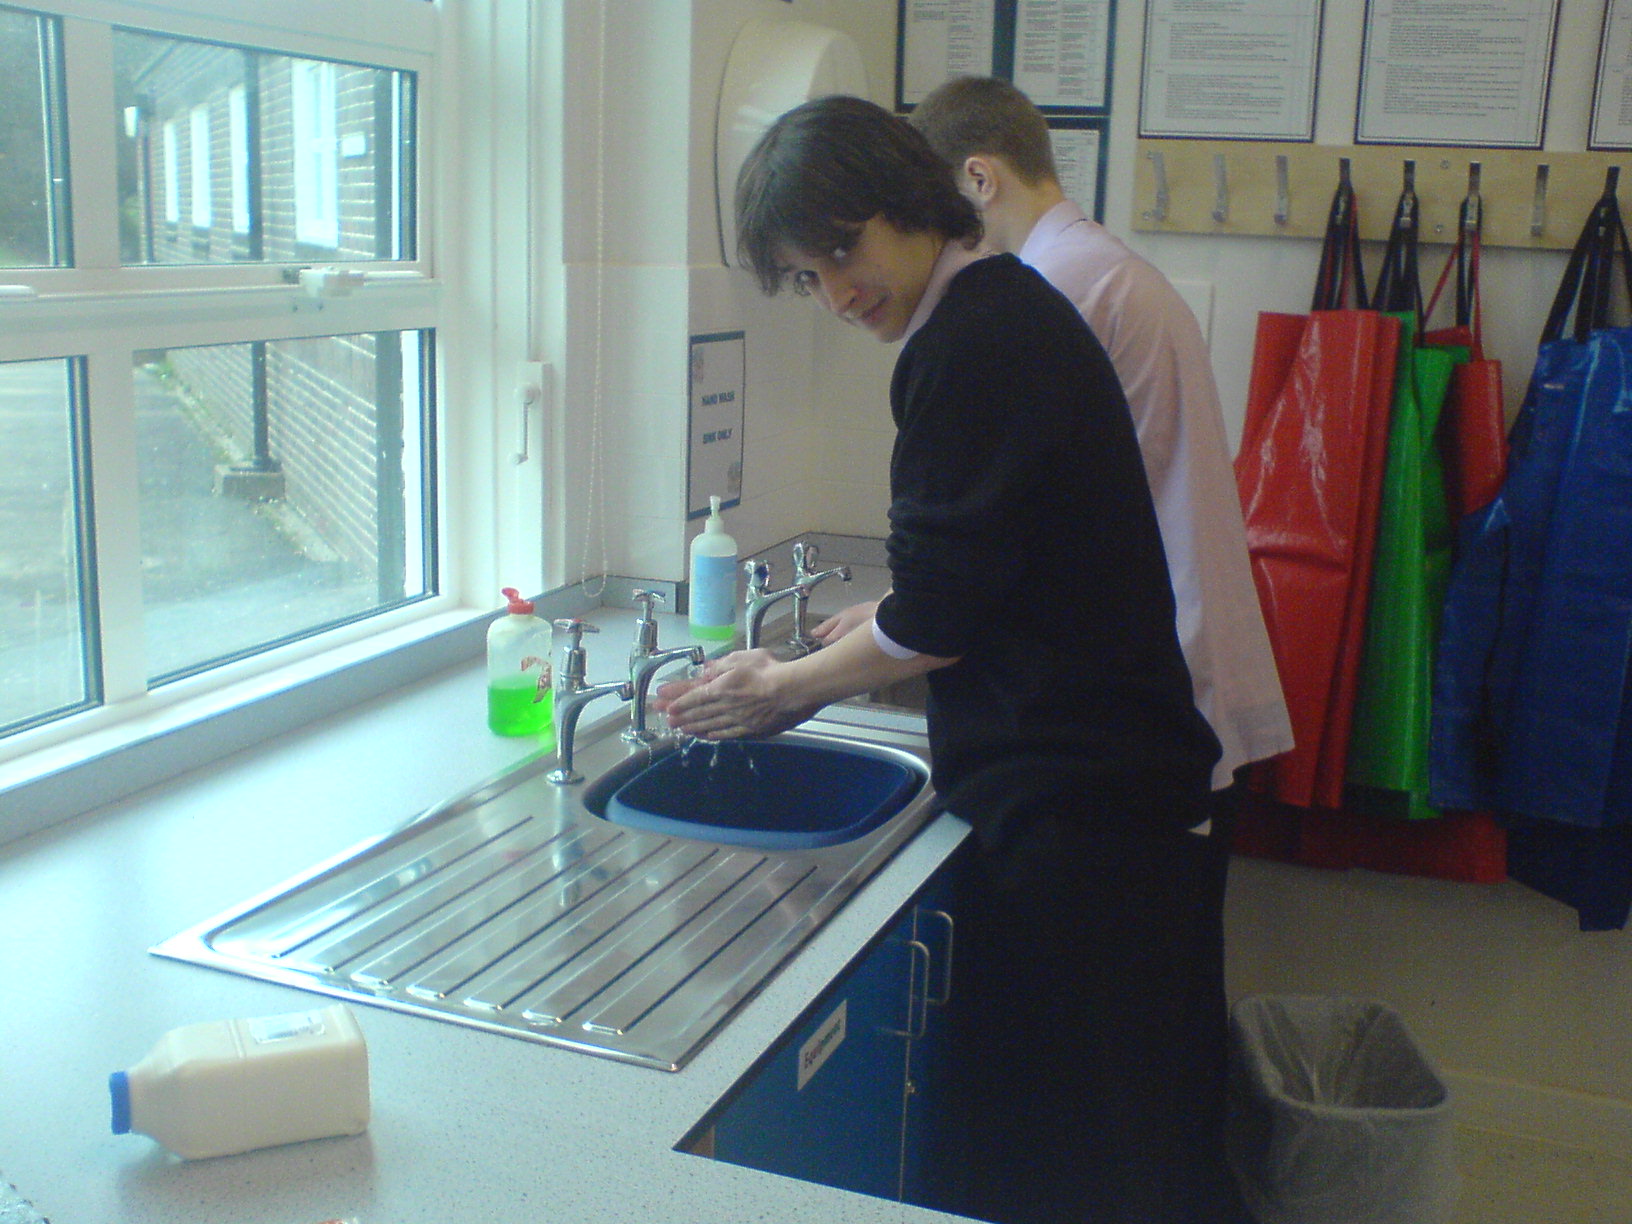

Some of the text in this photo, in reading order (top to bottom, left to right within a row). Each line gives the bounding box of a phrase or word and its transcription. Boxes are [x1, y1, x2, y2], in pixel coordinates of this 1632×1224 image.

[702, 391, 735, 406] HAND WASH
[717, 428, 733, 440] ONLY
